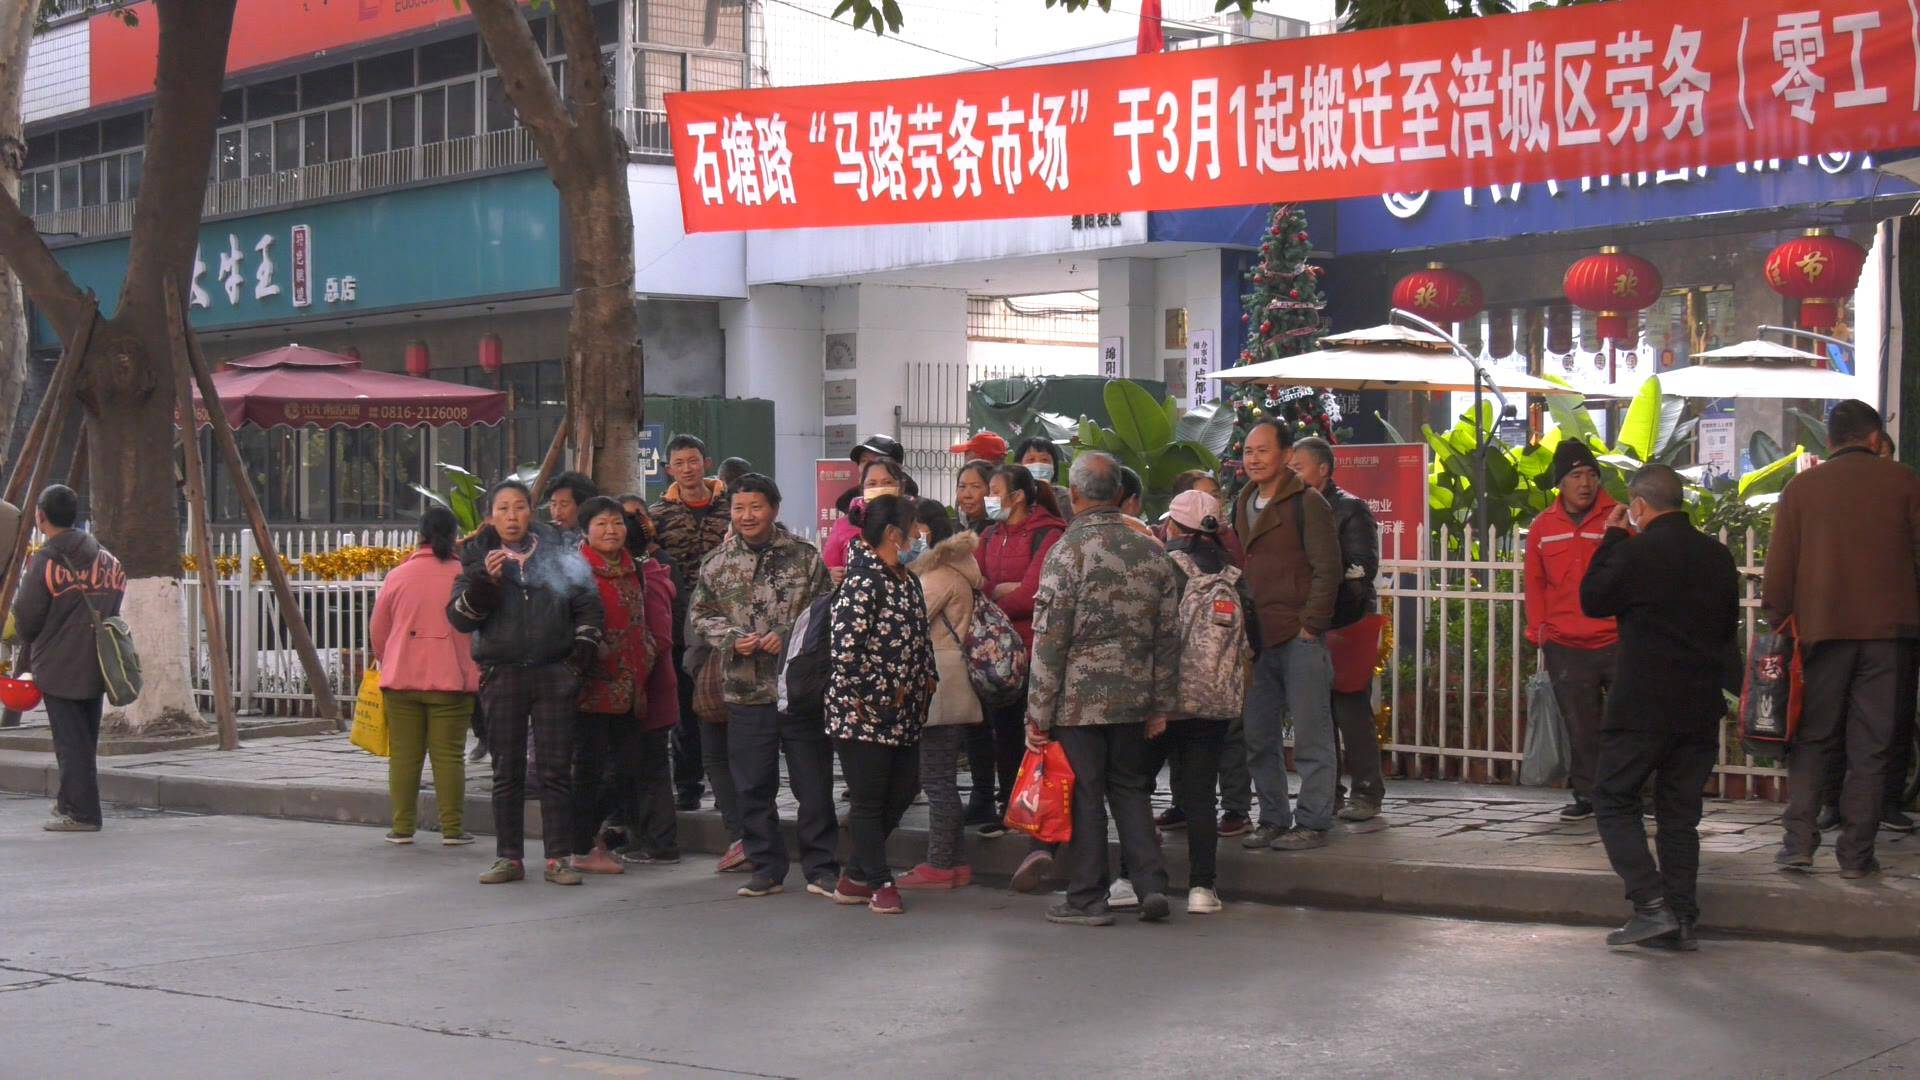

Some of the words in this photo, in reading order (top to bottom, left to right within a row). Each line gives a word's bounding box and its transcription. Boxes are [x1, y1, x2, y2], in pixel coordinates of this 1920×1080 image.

[1072, 212, 1122, 230] 绵阳校区
[324, 275, 356, 303] 总店
[1105, 346, 1117, 380] 绵阳
[381, 405, 469, 420] 0816-2126008
[1366, 498, 1392, 513] 物业
